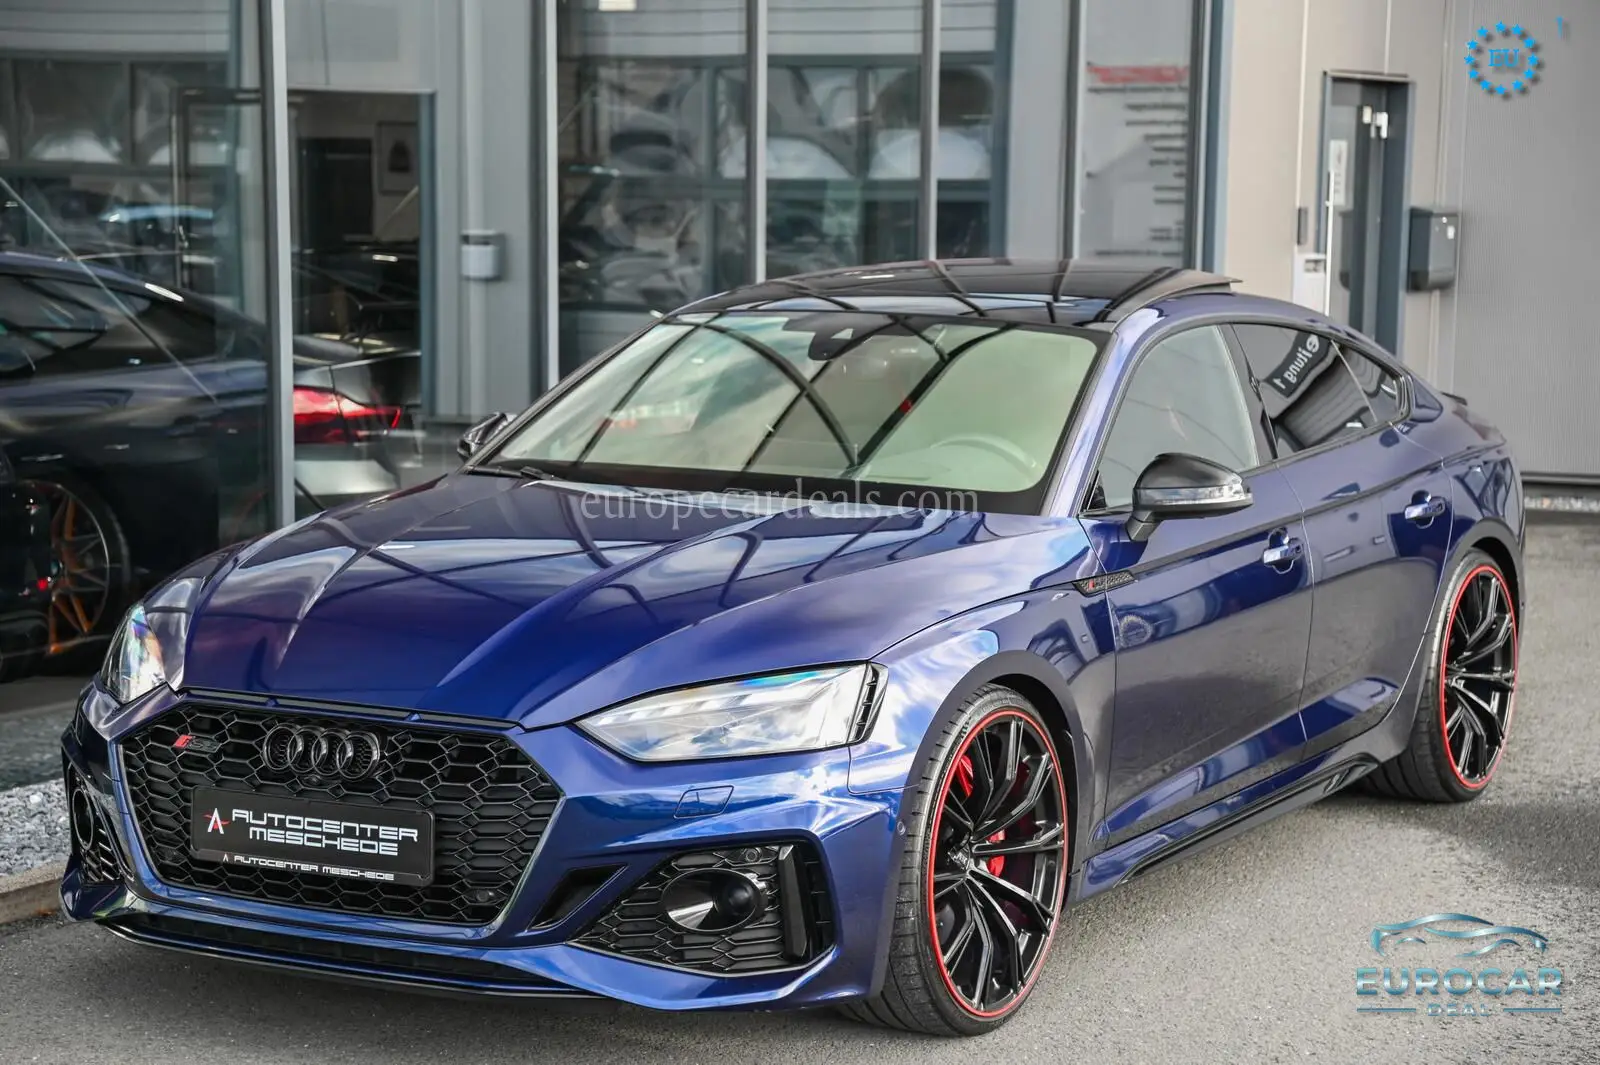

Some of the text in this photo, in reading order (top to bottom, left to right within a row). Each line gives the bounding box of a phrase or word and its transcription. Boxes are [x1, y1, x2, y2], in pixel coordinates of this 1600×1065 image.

[231, 808, 419, 842] AUTOCENTER
[249, 826, 399, 856] MESCHEDE
[234, 854, 319, 872] AUTOCENTER
[322, 865, 395, 881] MESCHEDE
